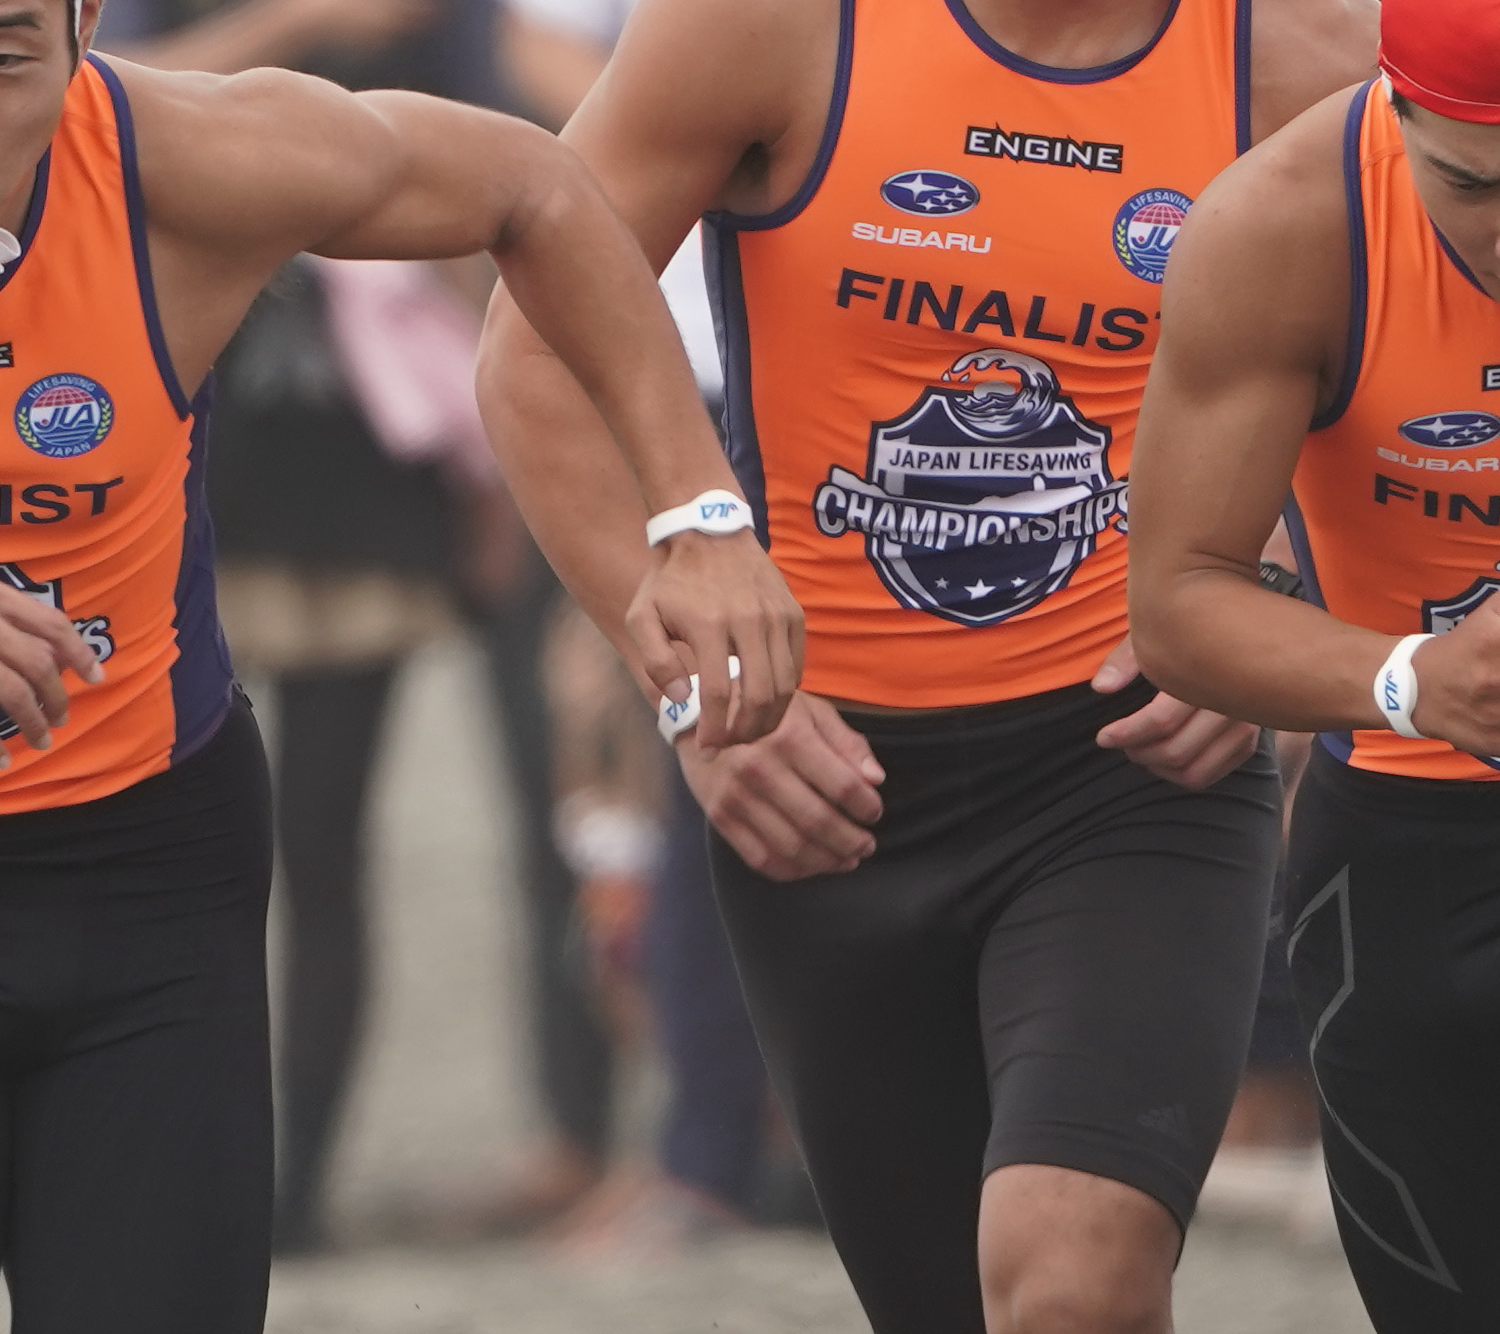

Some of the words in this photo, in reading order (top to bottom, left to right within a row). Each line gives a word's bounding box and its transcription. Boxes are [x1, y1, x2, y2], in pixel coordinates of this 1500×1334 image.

[967, 130, 1121, 169] ENGINE
[851, 221, 992, 255] SUBARU
[1137, 268, 1164, 281] JAP
[836, 266, 1161, 352] FINALIS
[27, 375, 97, 399] LIFESAVING
[33, 403, 95, 429] JLA
[46, 441, 91, 456] JAPAN
[889, 447, 961, 469] JAPAN
[969, 450, 1091, 471] LIFESAVING
